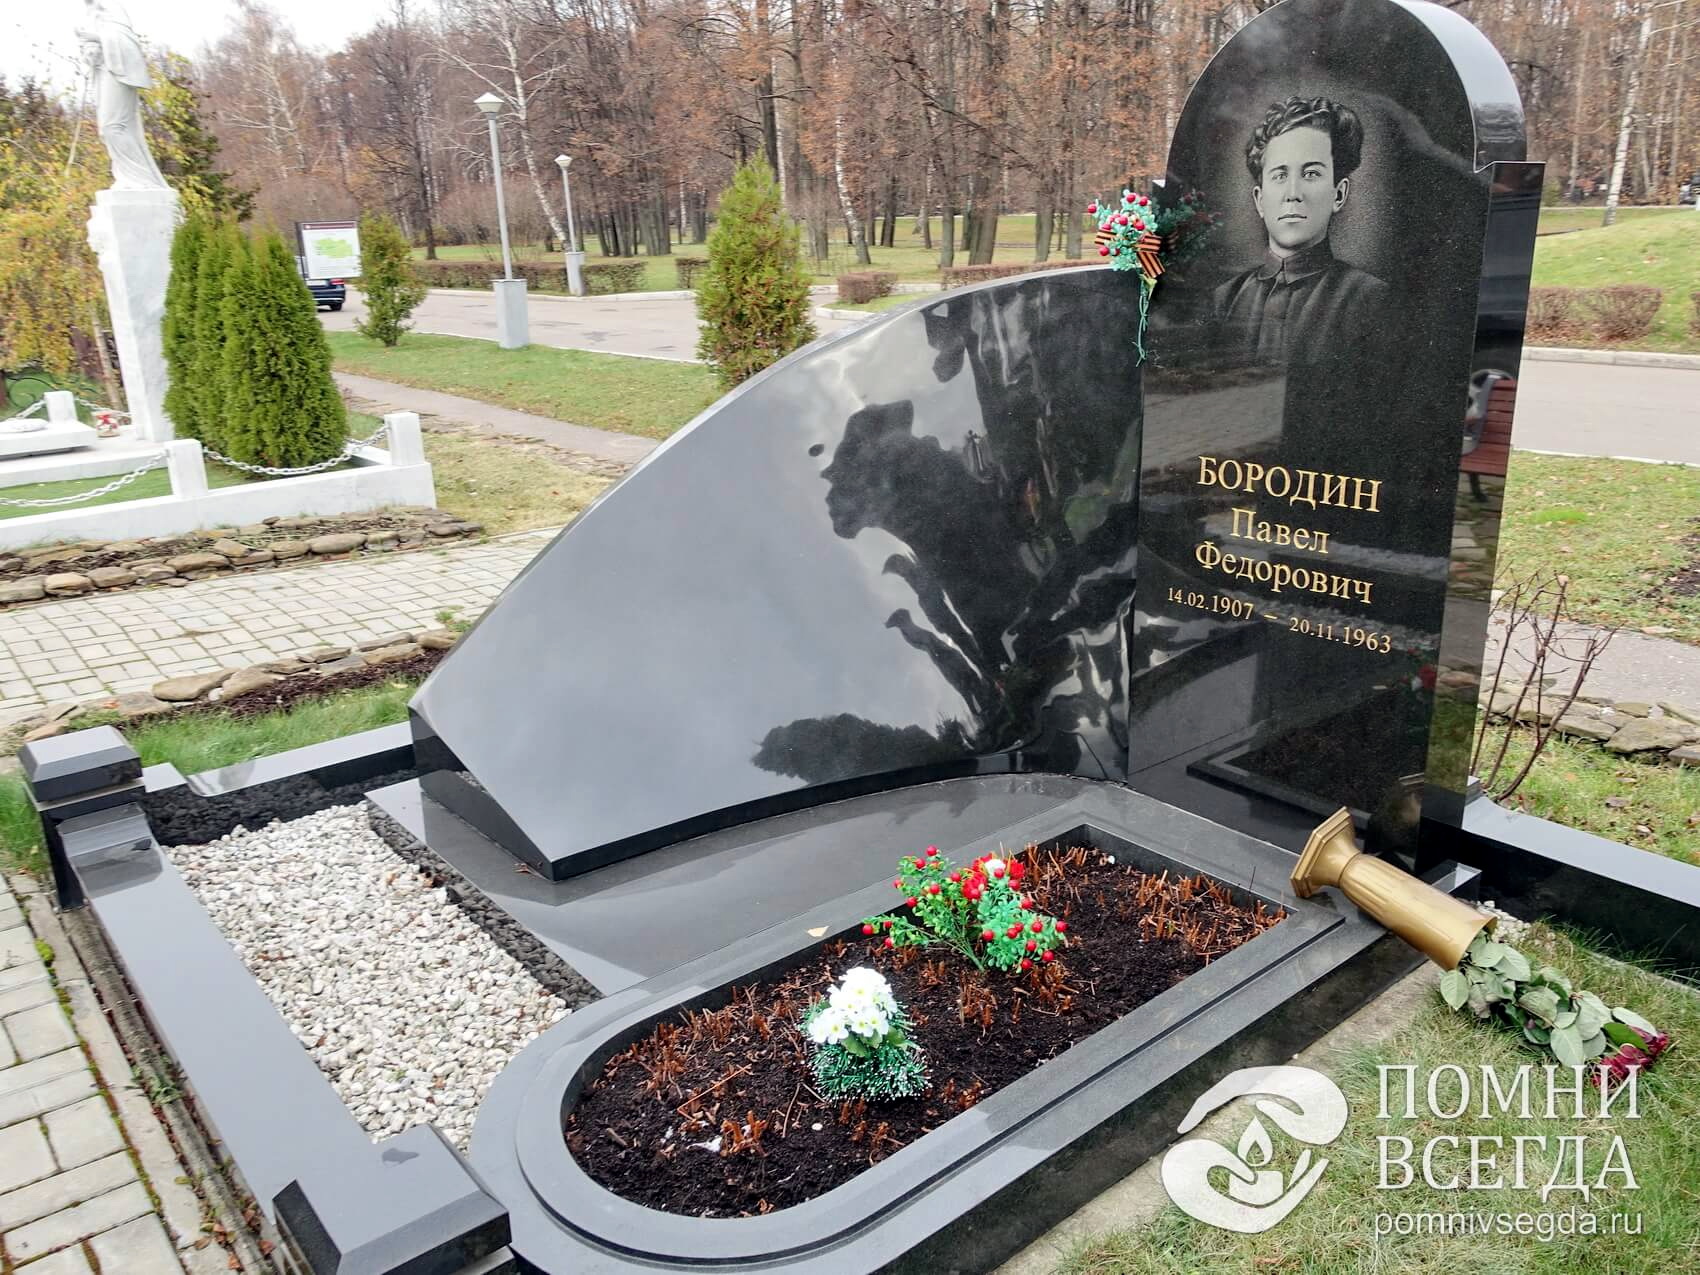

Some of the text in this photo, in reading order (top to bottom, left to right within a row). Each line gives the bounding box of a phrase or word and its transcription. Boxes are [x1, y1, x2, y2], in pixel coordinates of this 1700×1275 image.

[1197, 456, 1383, 513] БОРОДИН
[1230, 507, 1330, 554] Павел
[1195, 540, 1374, 604] Федорович
[1167, 587, 1255, 620] 14.02.1907
[1289, 617, 1392, 654] 20.11.1963
